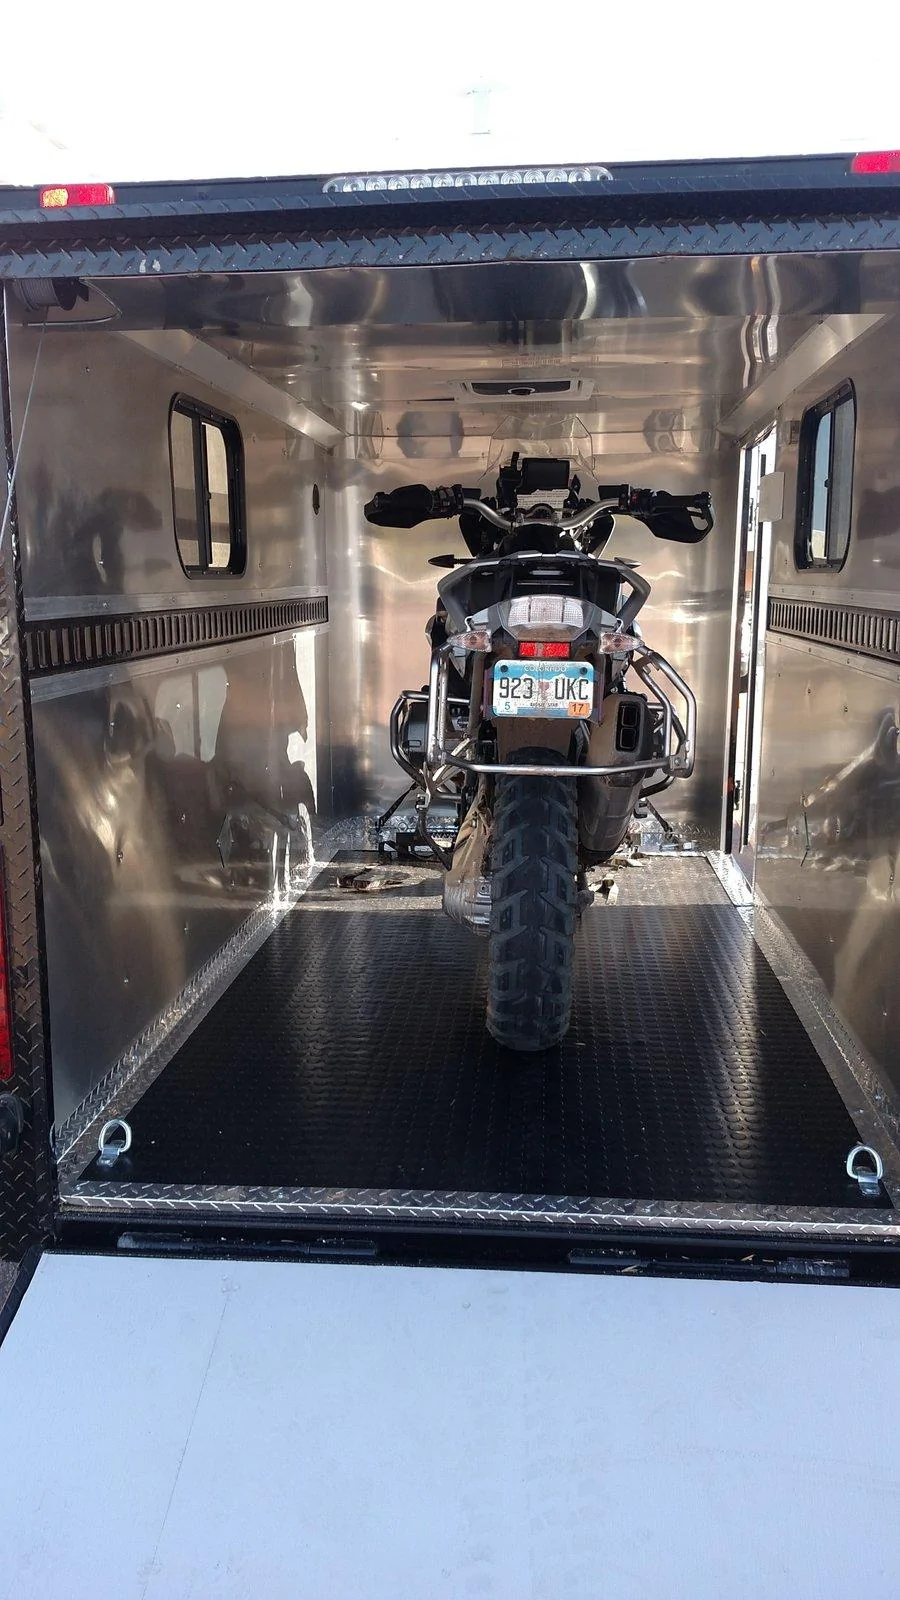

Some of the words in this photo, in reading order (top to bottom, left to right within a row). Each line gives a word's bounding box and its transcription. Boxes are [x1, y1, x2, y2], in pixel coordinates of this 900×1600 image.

[499, 677, 533, 699] 923
[555, 678, 589, 700] UKC
[504, 701, 511, 711] 5
[571, 703, 584, 713] 17
